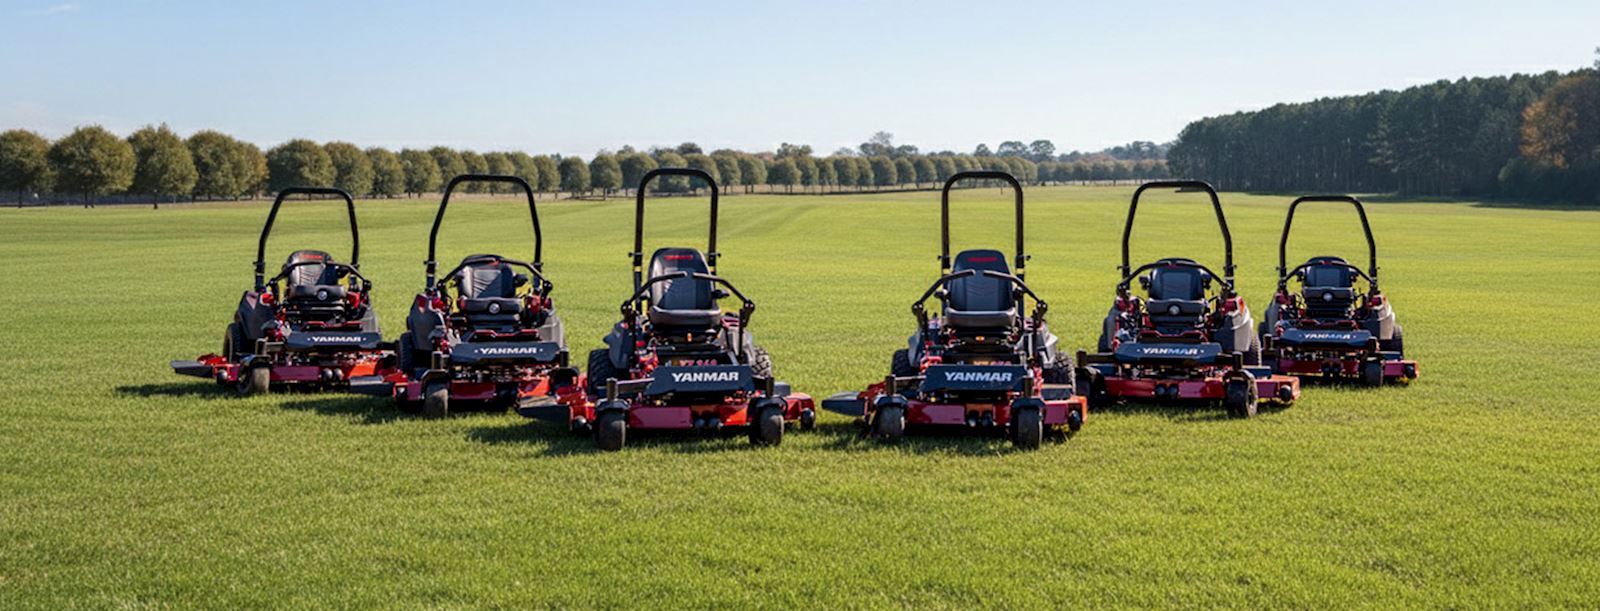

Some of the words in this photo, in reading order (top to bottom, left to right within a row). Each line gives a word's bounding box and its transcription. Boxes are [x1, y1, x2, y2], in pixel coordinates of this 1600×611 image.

[480, 347, 537, 355] YANMAR
[1143, 347, 1198, 355] YANMAR
[671, 371, 739, 382] YANMAR
[944, 371, 1013, 382] YANMAR
